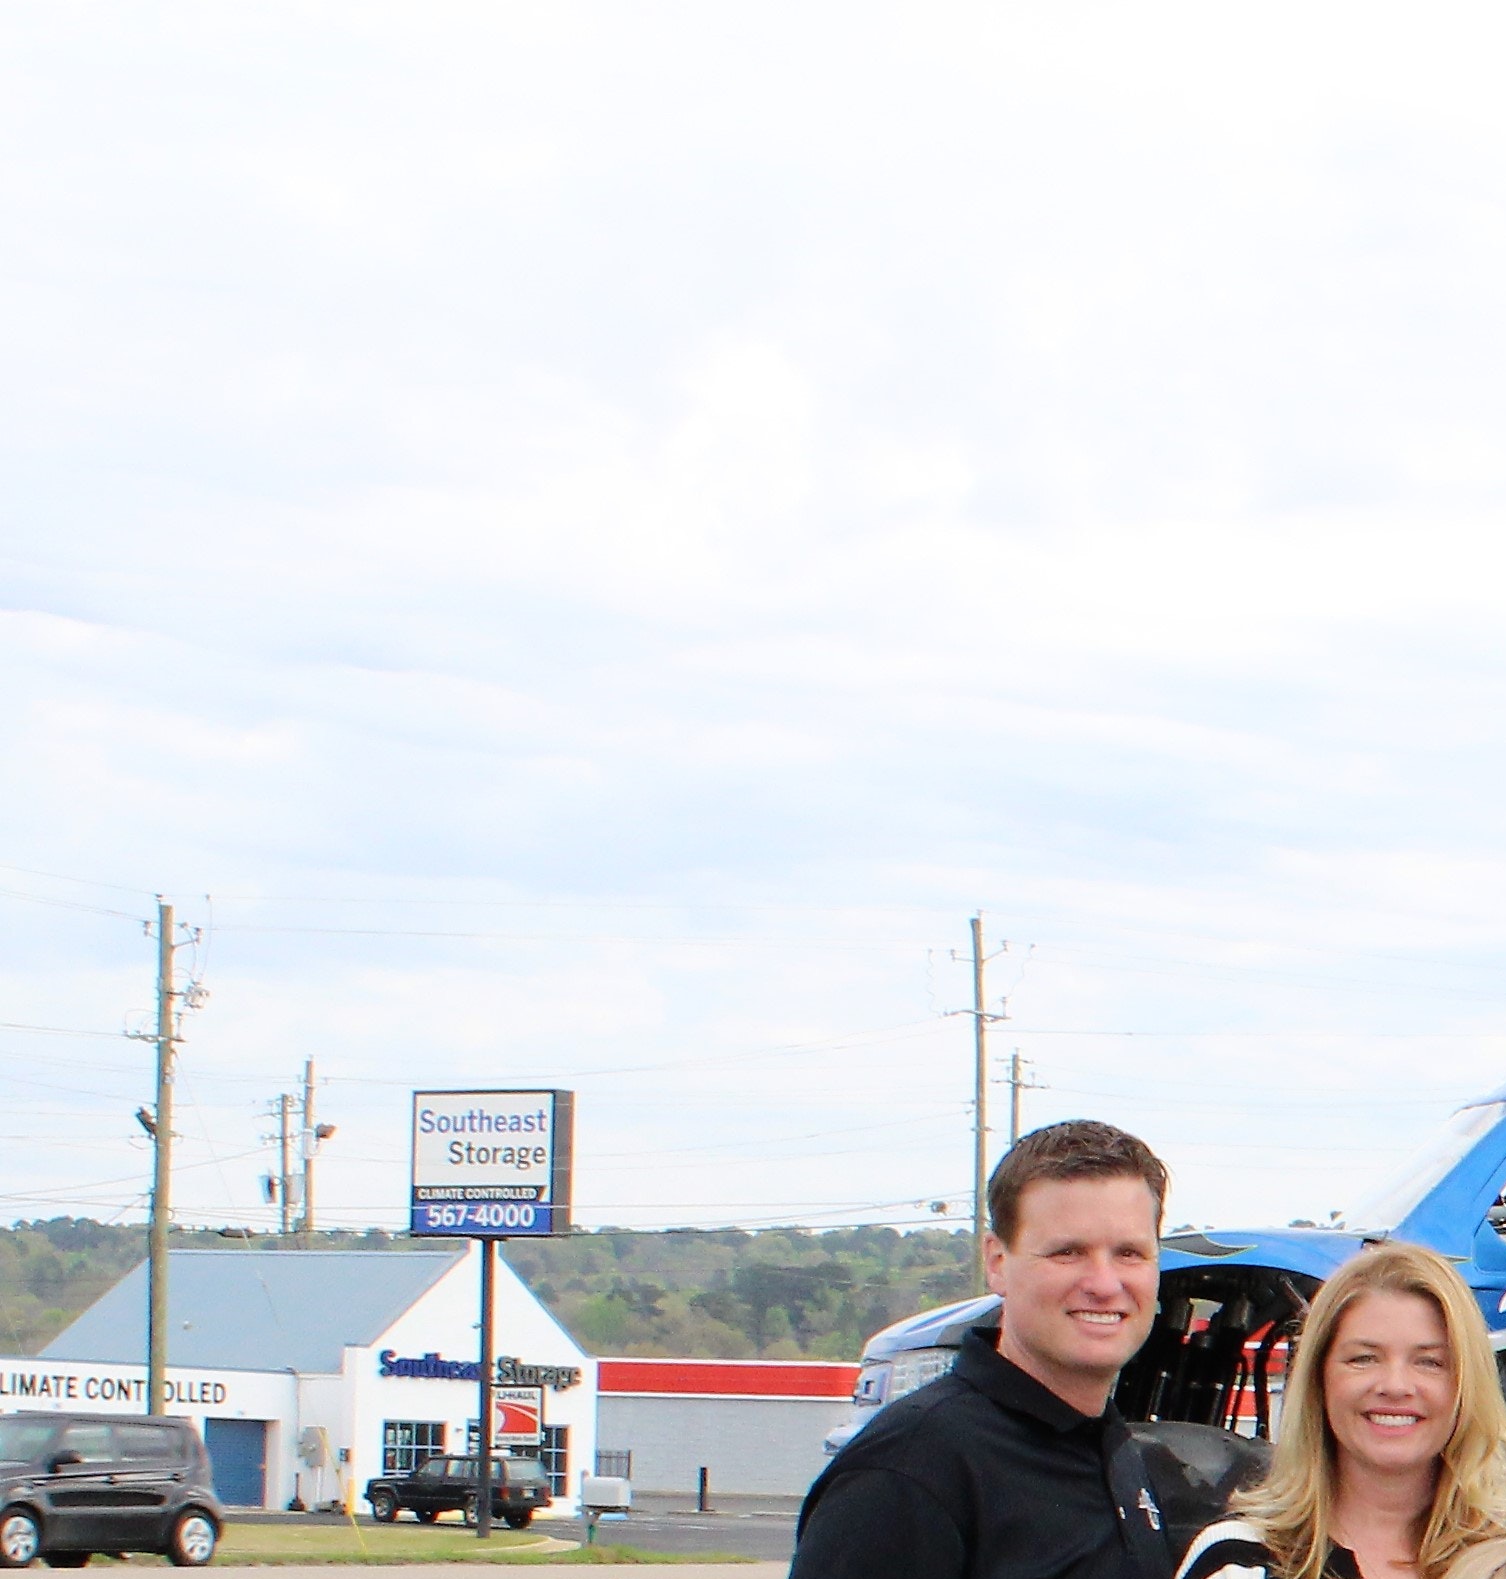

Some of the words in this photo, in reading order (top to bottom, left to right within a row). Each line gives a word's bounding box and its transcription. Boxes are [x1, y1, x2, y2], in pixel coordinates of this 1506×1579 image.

[420, 1108, 548, 1134] Southeast
[449, 1140, 547, 1170] Storage
[418, 1188, 464, 1200] CLIMATE
[465, 1188, 538, 1200] CONTROLLED
[426, 1203, 536, 1228] 567-4000
[498, 1355, 582, 1392] Storage
[0, 1371, 79, 1399] LIMATE
[86, 1376, 227, 1405] CONTOLLED
